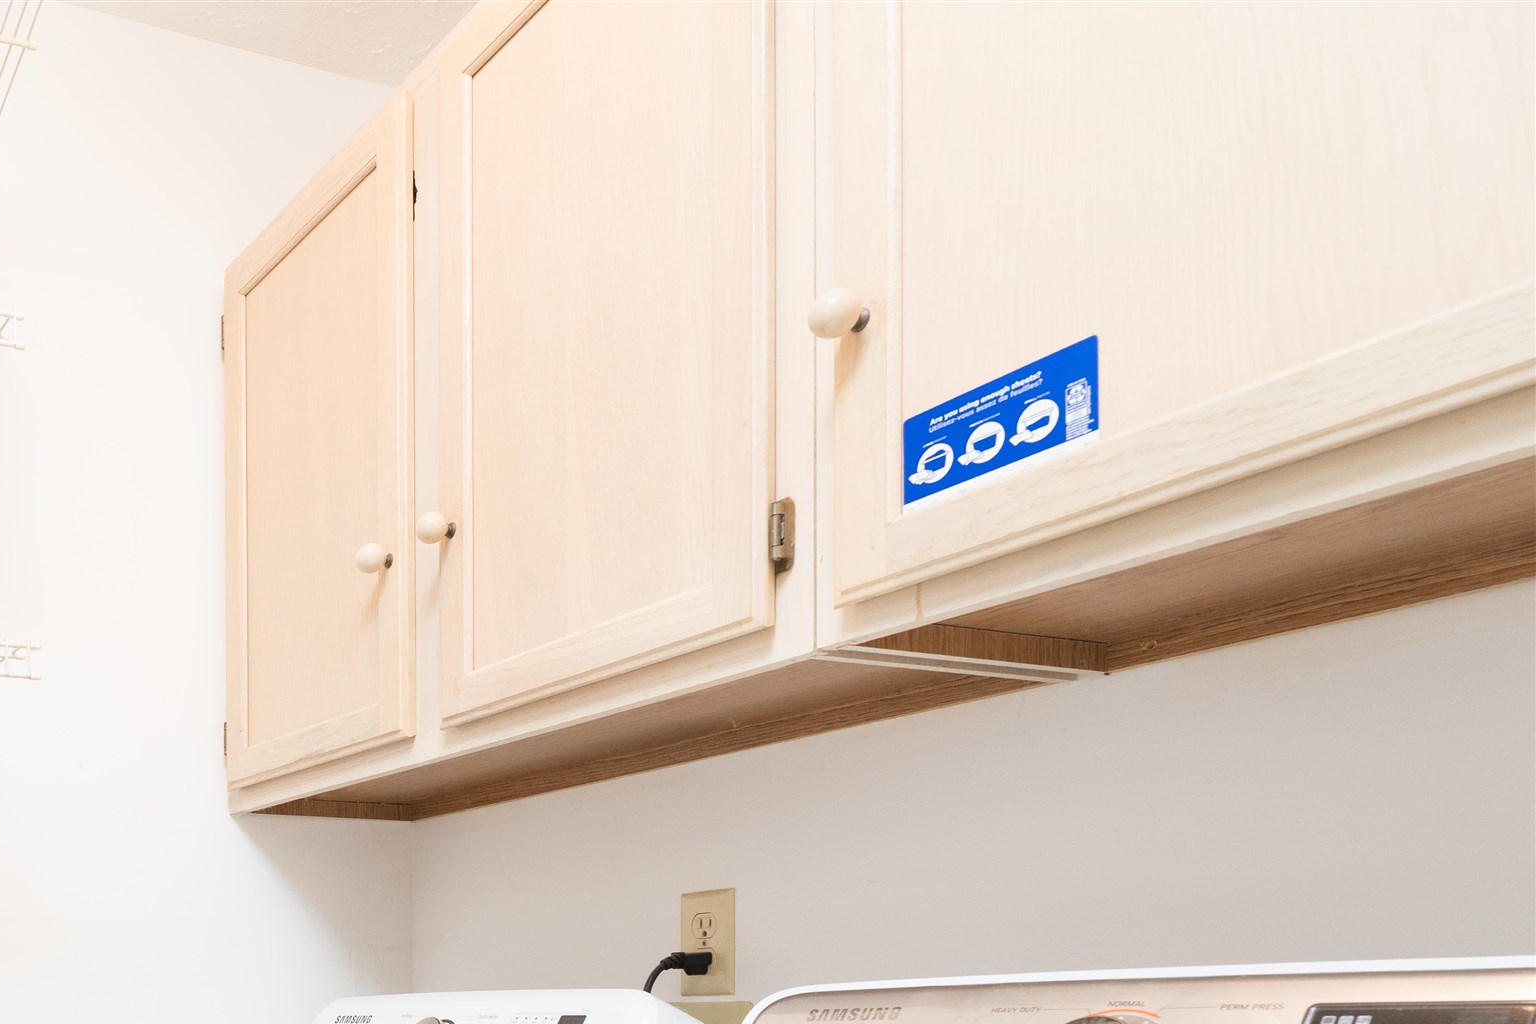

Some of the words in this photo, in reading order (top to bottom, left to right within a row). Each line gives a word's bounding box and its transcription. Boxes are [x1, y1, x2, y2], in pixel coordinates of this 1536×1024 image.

[1107, 1000, 1147, 1008] NORMAL
[1252, 1003, 1285, 1011] PRESS
[334, 1013, 373, 1024] SAMSUNG
[806, 1006, 903, 1023] SAMSUNG
